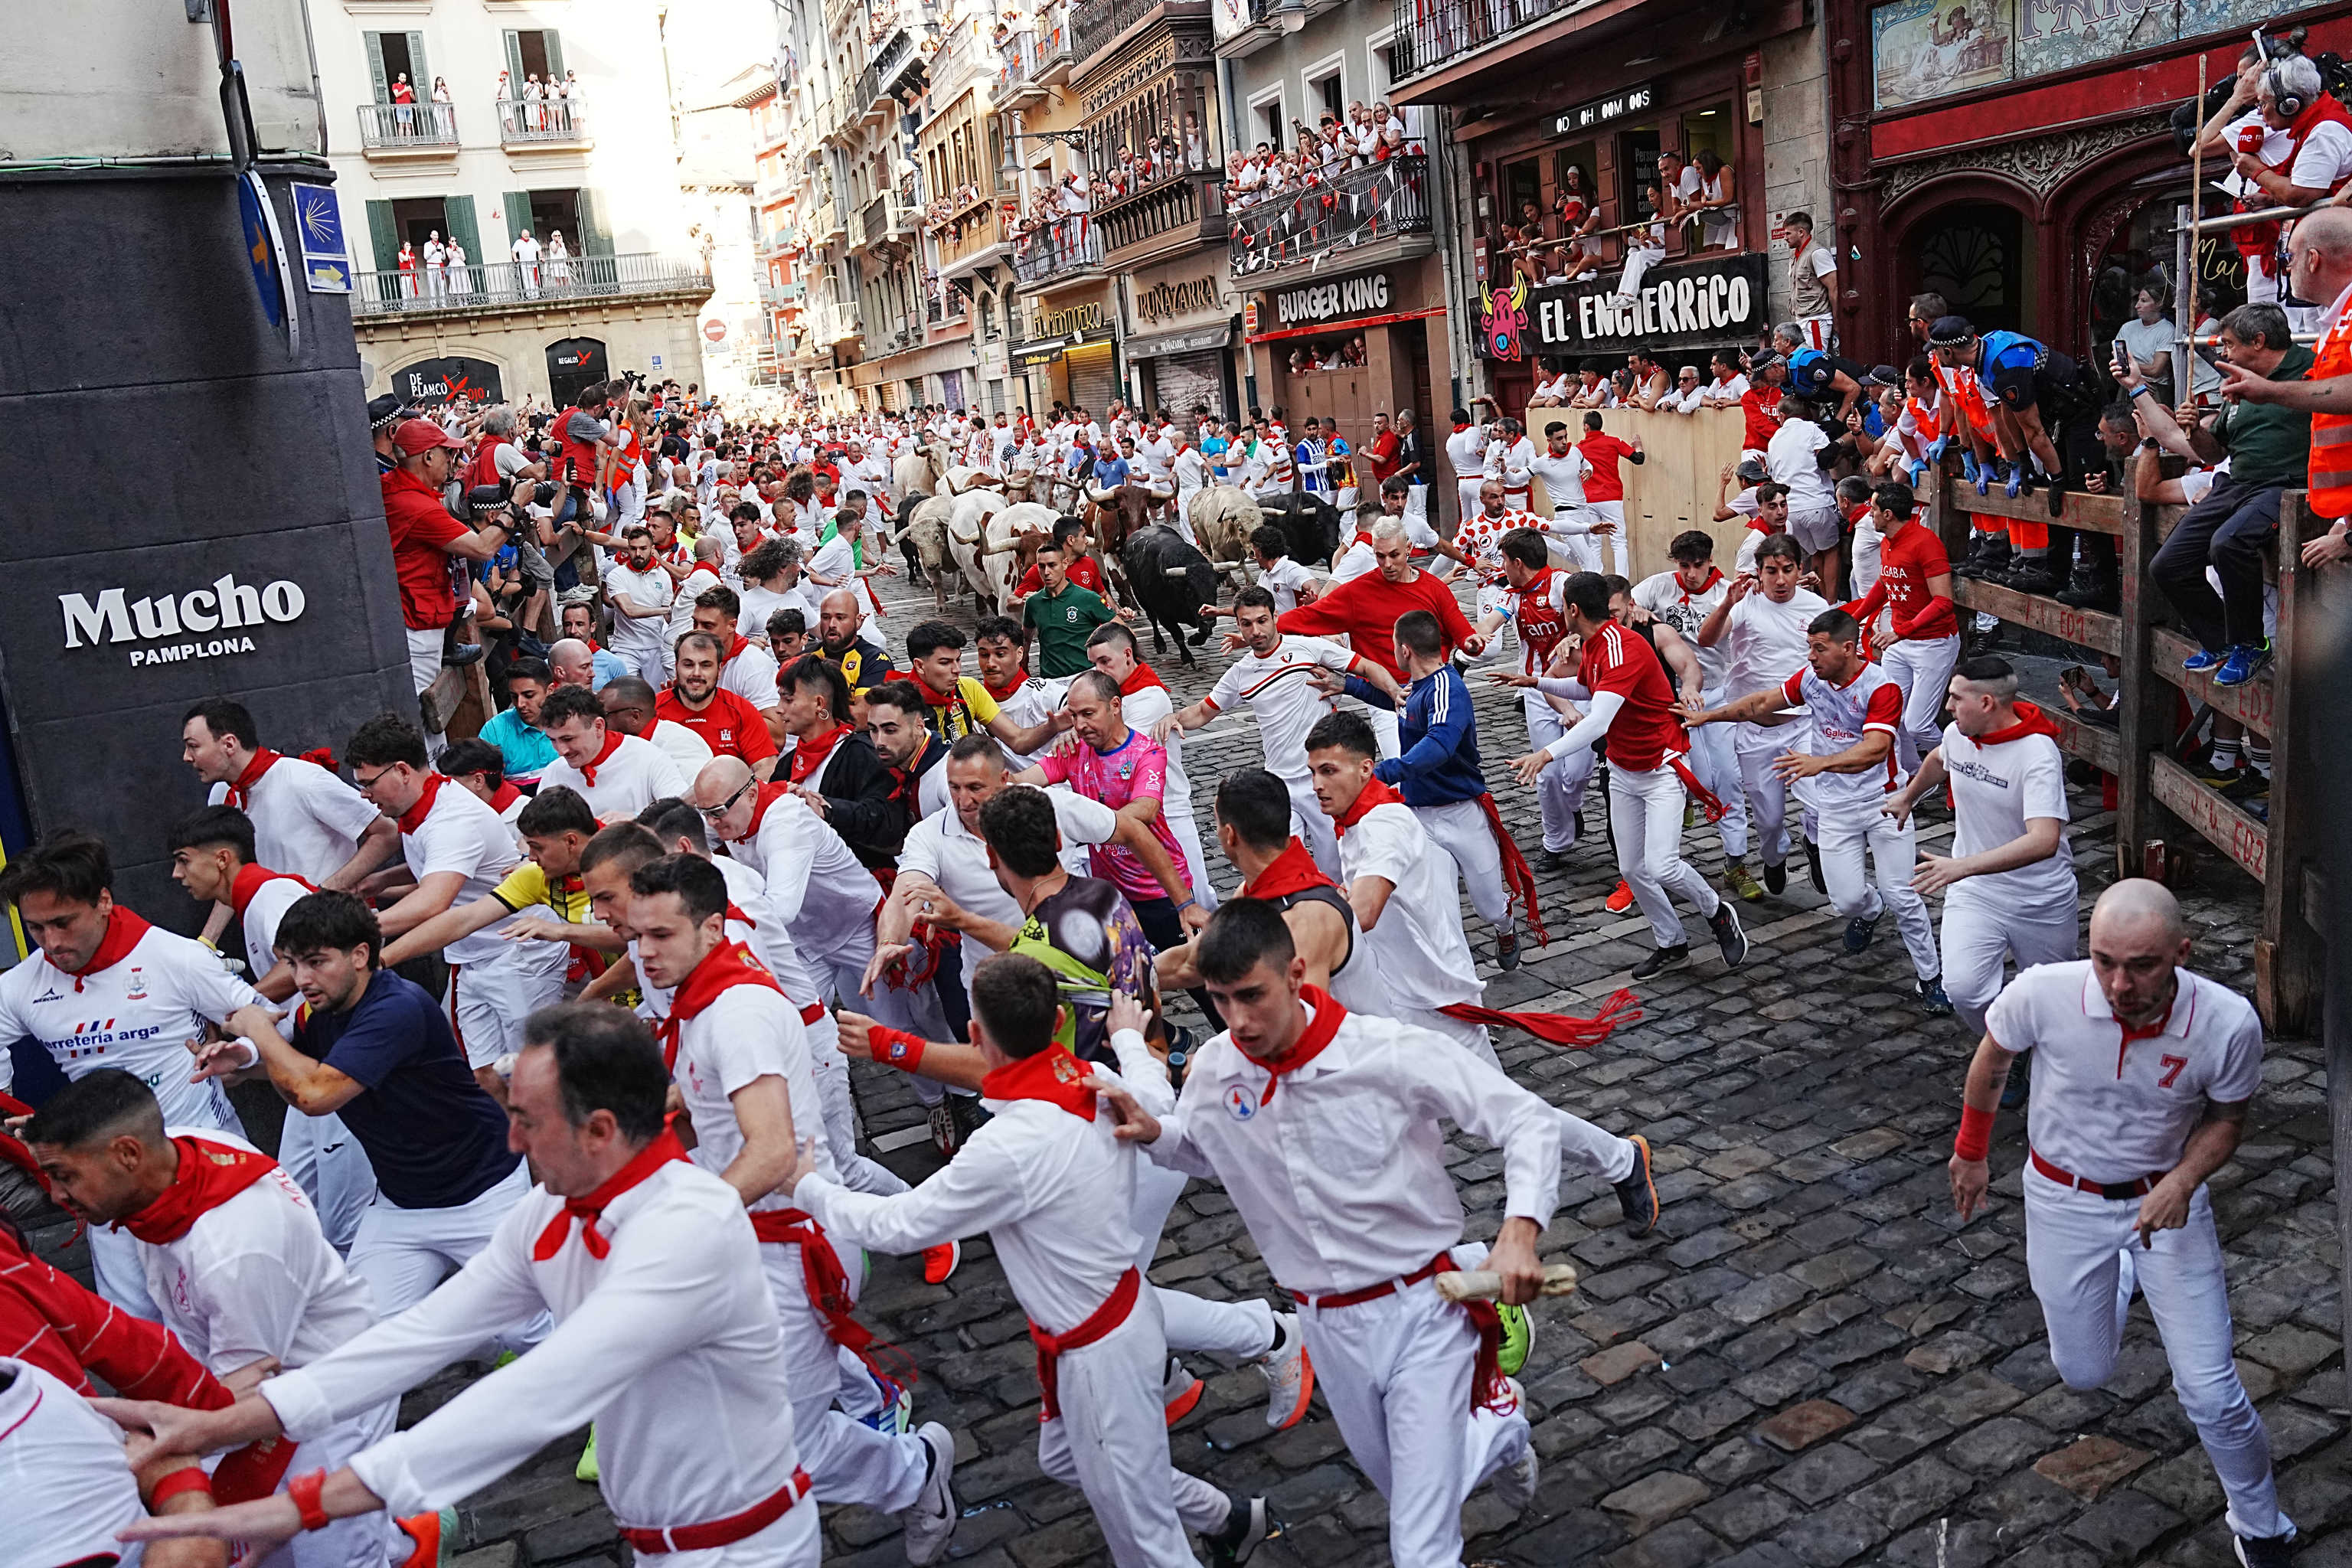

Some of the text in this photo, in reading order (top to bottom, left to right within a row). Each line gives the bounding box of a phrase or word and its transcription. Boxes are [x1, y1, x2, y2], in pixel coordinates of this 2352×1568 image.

[2239, 134, 2252, 142] rne
[1278, 273, 1389, 323] BURGER KING
[1034, 302, 1102, 338] EL MENTIDERO
[1539, 298, 1570, 344] EL
[558, 356, 579, 364] REGALOS
[409, 372, 422, 386] DE
[57, 573, 305, 649] Mucho
[129, 635, 256, 668] PAMPLONA
[41, 1026, 160, 1050] erretería arga
[2158, 1054, 2187, 1088] 7
